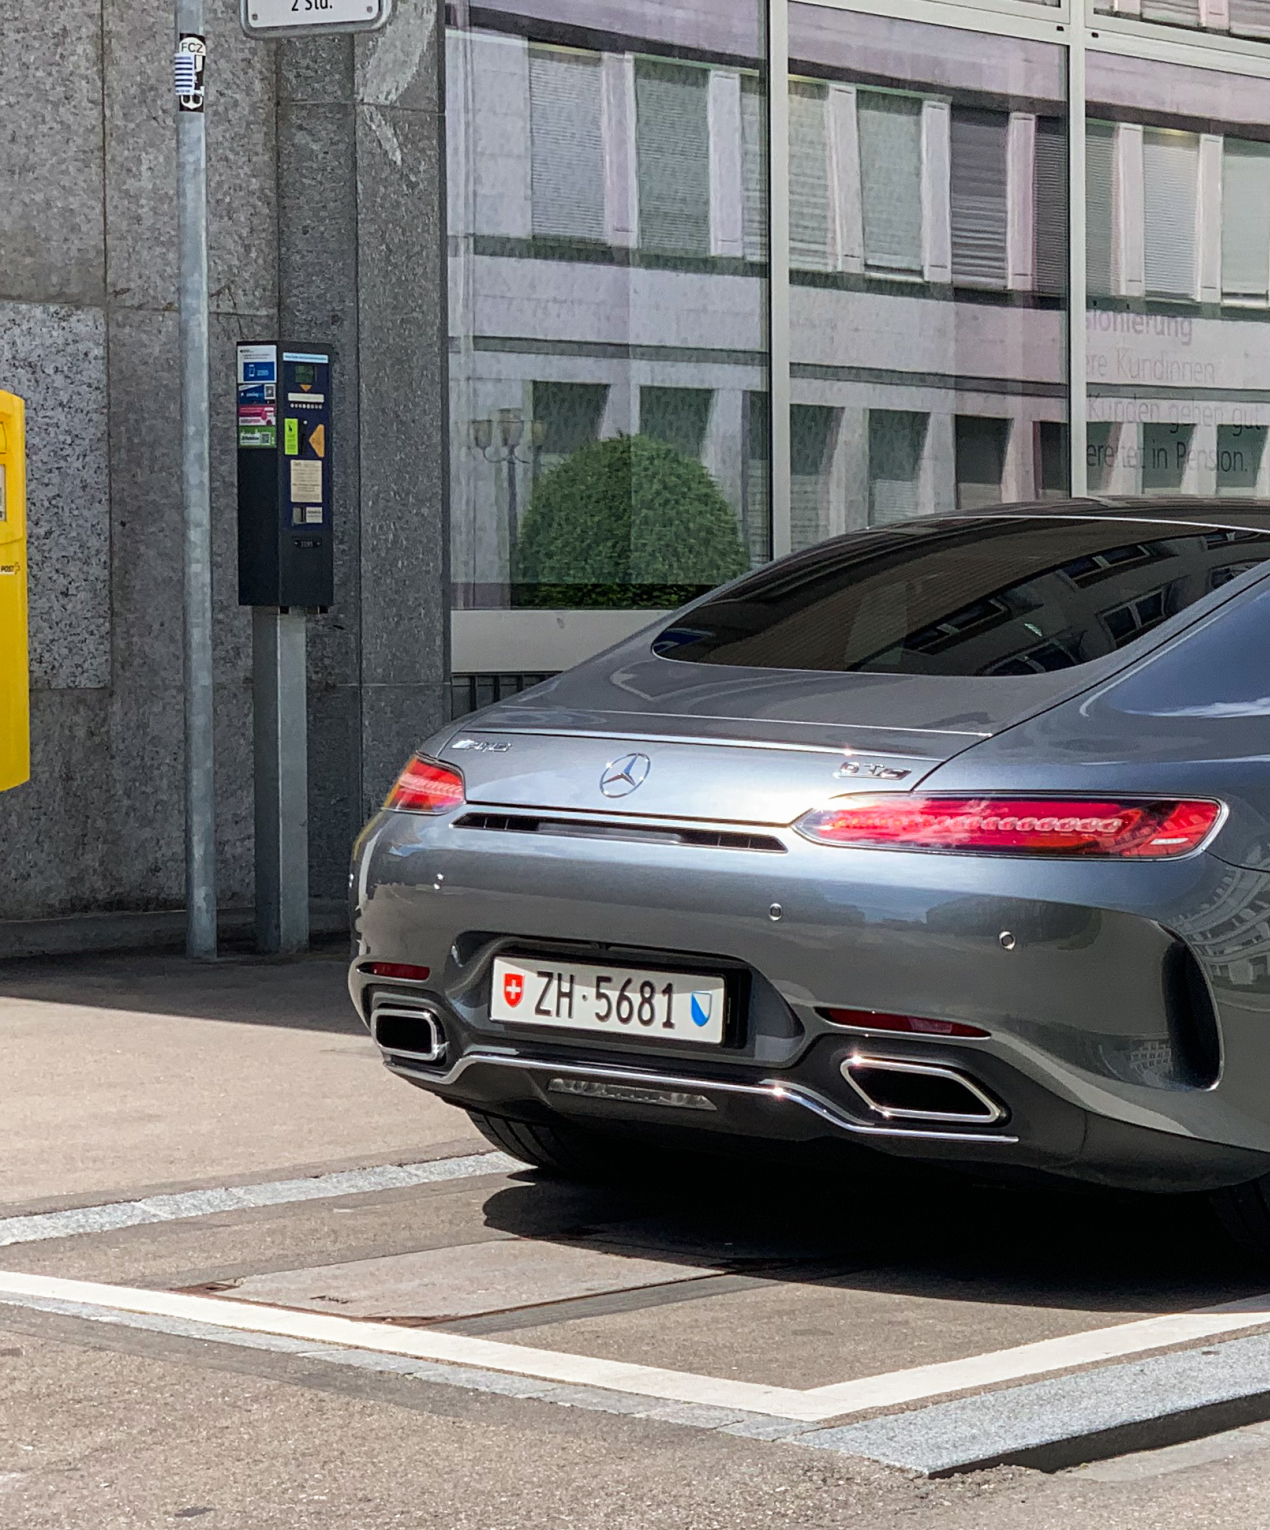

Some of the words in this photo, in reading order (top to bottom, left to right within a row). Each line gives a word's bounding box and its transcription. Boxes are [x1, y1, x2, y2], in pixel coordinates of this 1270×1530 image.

[181, 42, 203, 54] FCZ
[1117, 348, 1215, 383] Kundinnen
[1087, 393, 1160, 419] Kunden
[1168, 397, 1224, 433] gehen
[1231, 403, 1262, 436] gut
[1152, 438, 1168, 469] in
[1177, 441, 1248, 472] Pension.
